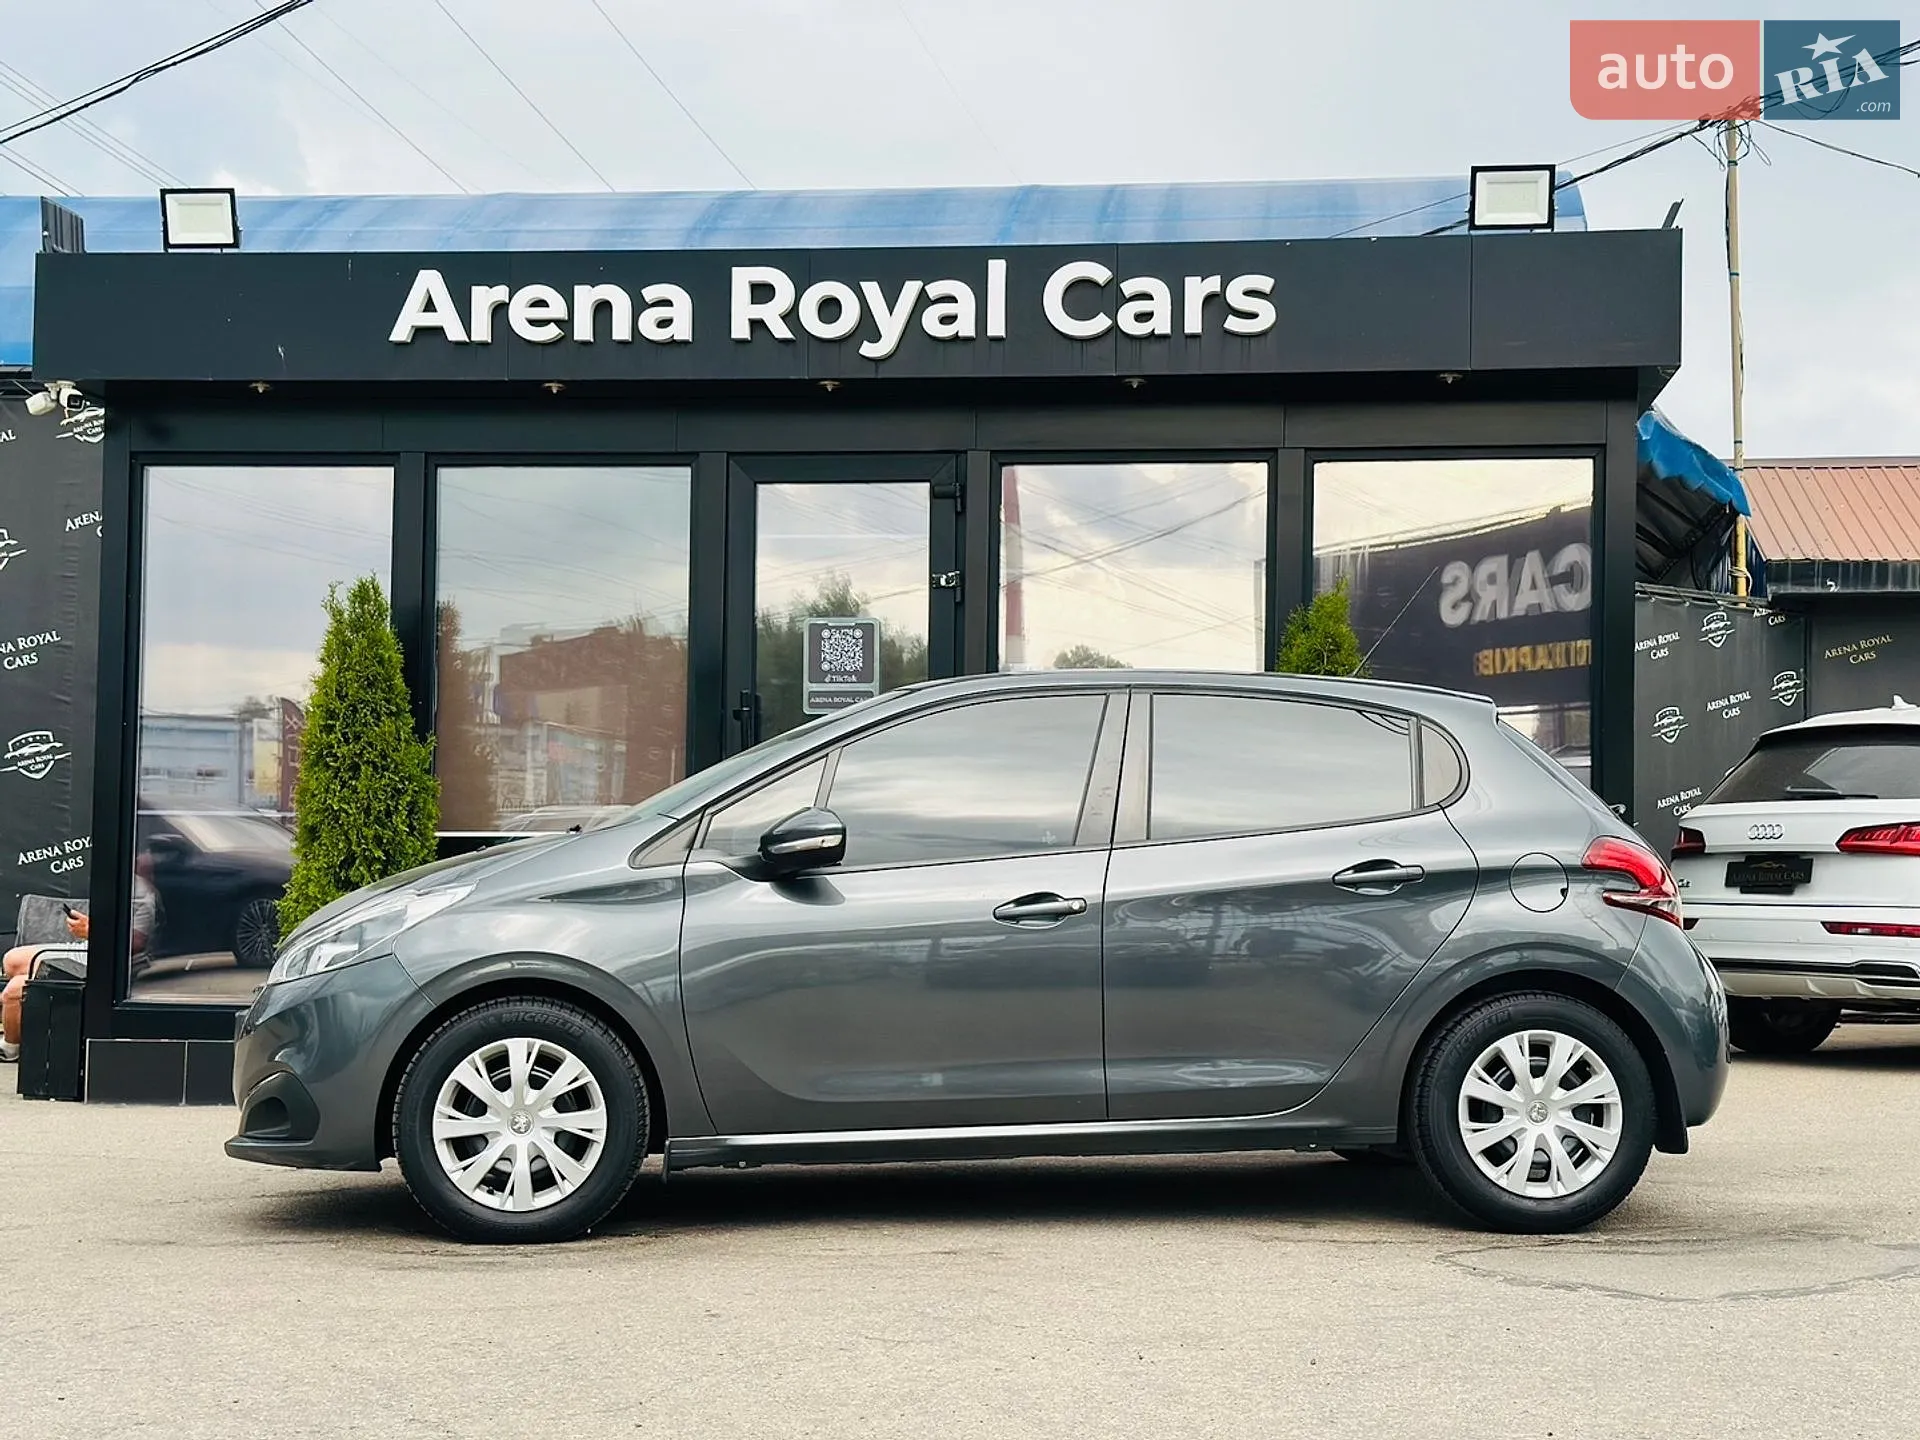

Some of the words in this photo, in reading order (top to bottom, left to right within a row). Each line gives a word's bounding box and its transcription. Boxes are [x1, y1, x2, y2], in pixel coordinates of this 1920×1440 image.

[388, 269, 693, 343] Arena
[730, 258, 1007, 360] Royal
[1042, 260, 1277, 340] Cars
[17, 630, 61, 648] ROYAL
[1824, 643, 1858, 659] ARENA
[1859, 634, 1893, 650] ROYAL
[3, 652, 39, 670] CARS
[1650, 647, 1669, 660] CARS
[1850, 651, 1876, 664] CARS
[1706, 697, 1729, 712] ARENA
[1729, 690, 1752, 704] ROYAL
[1722, 706, 1741, 719] CARS
[1657, 794, 1680, 809] ARENA
[1680, 786, 1702, 801] ROYAL
[17, 845, 63, 866] ARENA
[63, 836, 93, 854] ROY
[50, 855, 84, 874] CARS
